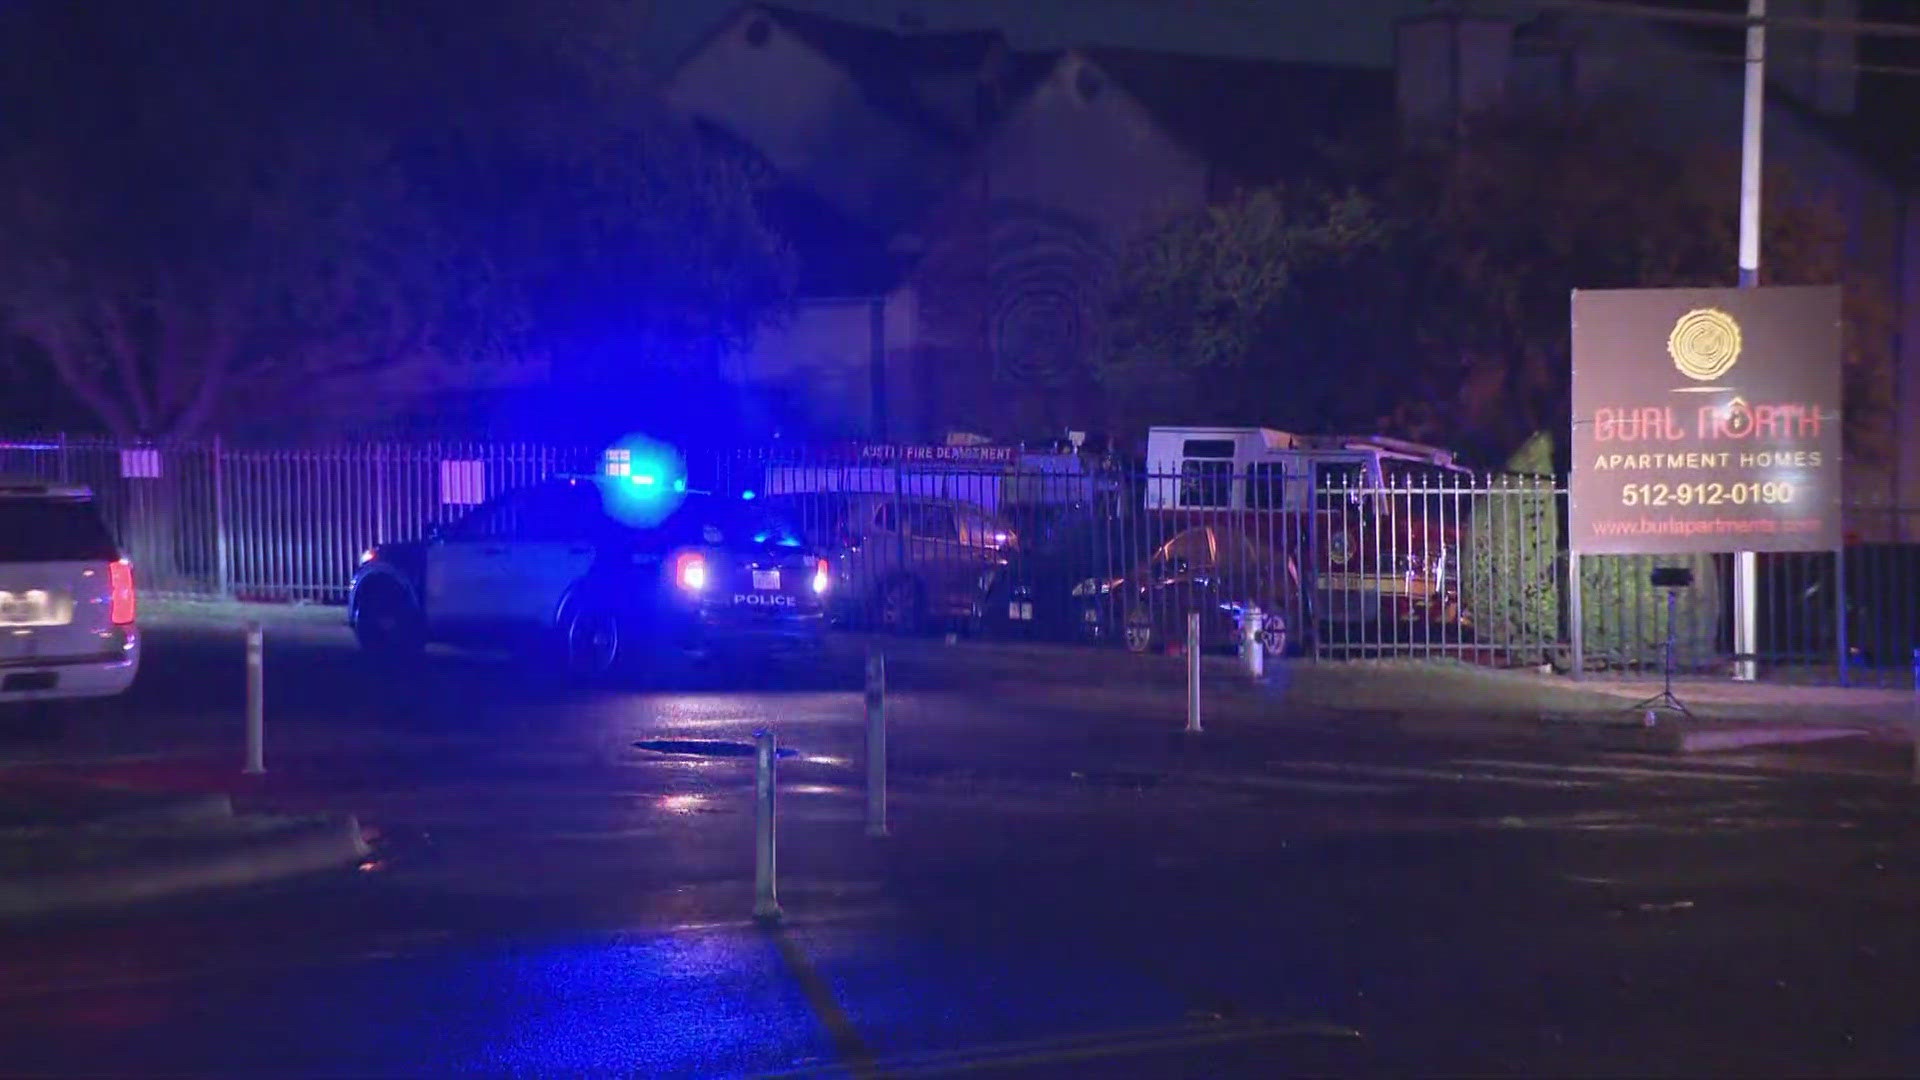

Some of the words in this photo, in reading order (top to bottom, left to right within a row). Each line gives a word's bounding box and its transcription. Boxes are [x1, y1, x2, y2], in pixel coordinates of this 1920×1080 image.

[1594, 406, 1685, 442] BURL
[906, 446, 933, 460] FIRE
[1594, 453, 1730, 471] APARTMENT
[1740, 451, 1823, 468] HOMES
[1622, 482, 1795, 507] 512-912-0190
[1591, 515, 1822, 537] www.burlapartments
[733, 594, 797, 607] POLICE
